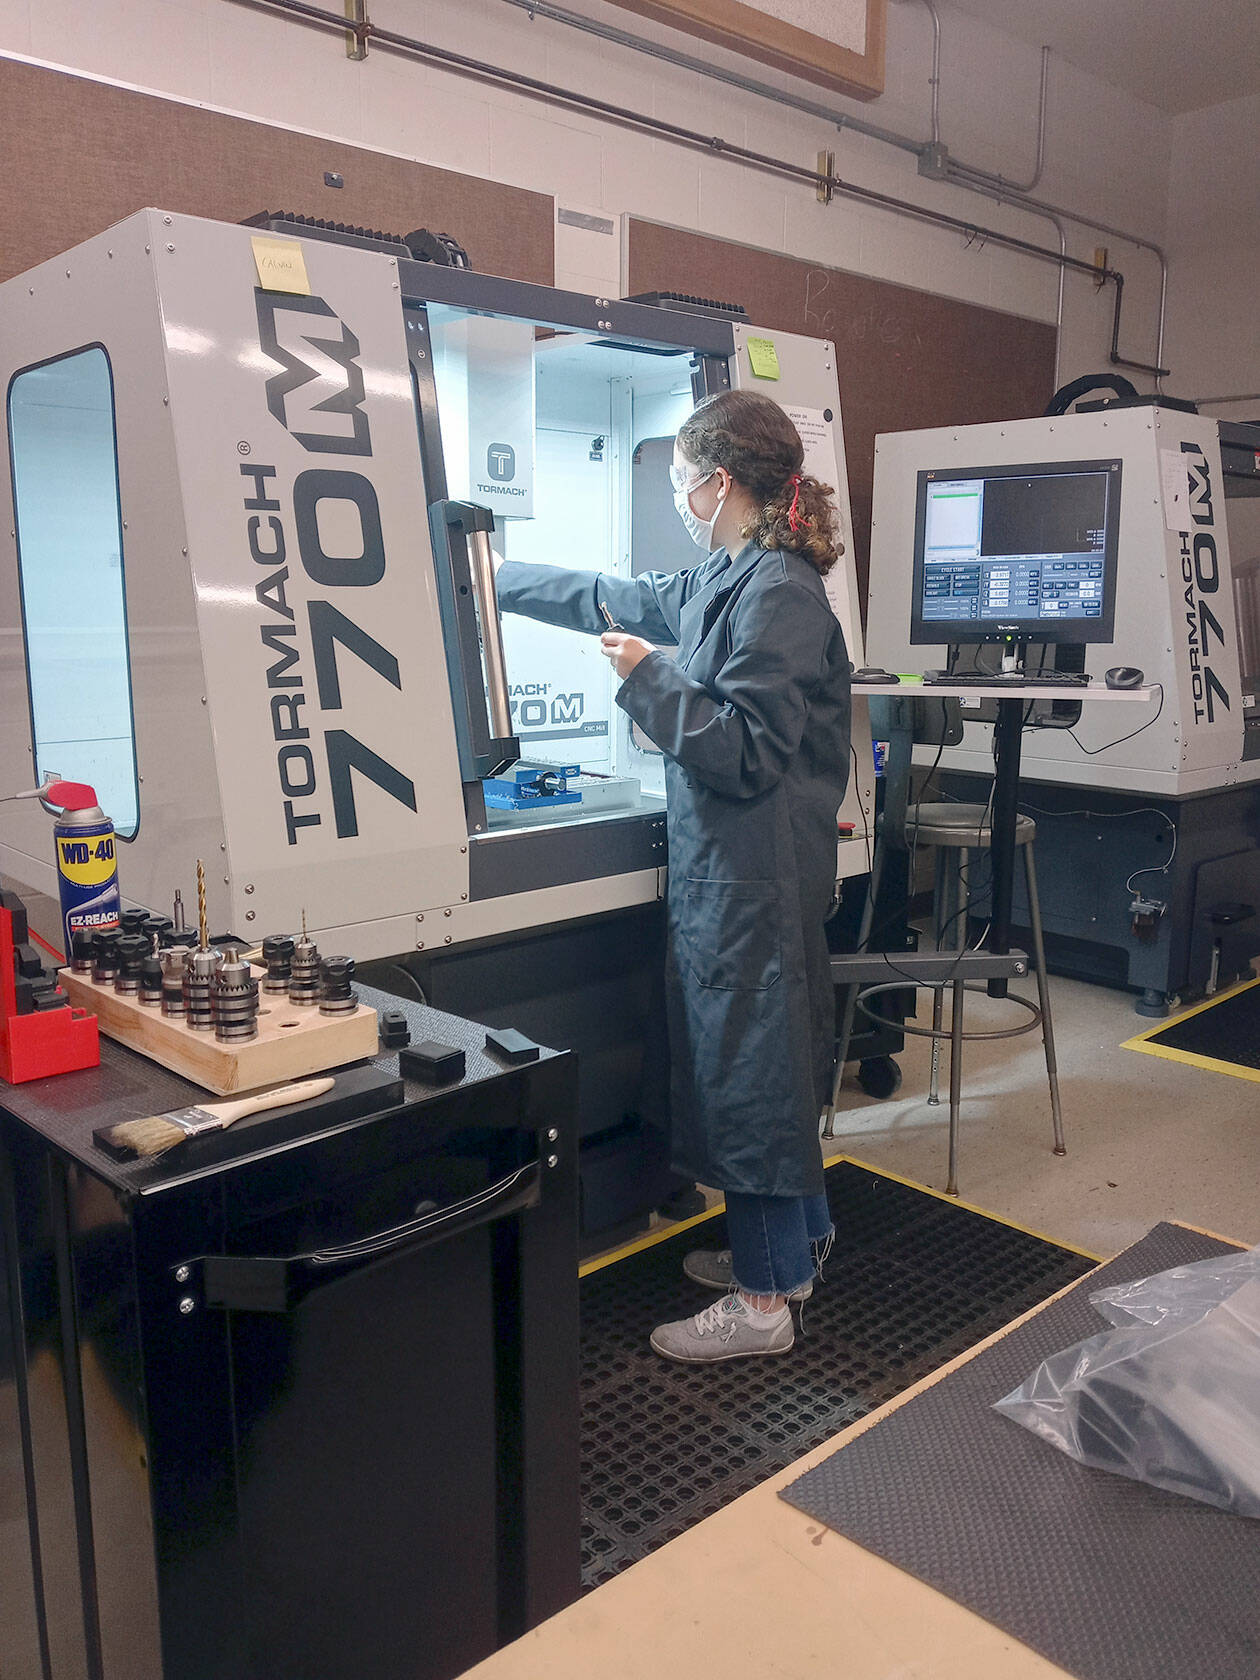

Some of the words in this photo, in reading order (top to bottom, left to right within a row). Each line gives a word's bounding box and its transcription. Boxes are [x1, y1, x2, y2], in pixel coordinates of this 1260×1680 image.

[254, 286, 417, 839] 770M
[1180, 441, 1231, 723] 770M
[1180, 531, 1206, 724] TORMACH
[61, 838, 114, 864] WD-40
[70, 911, 118, 926] EZ-REACH
